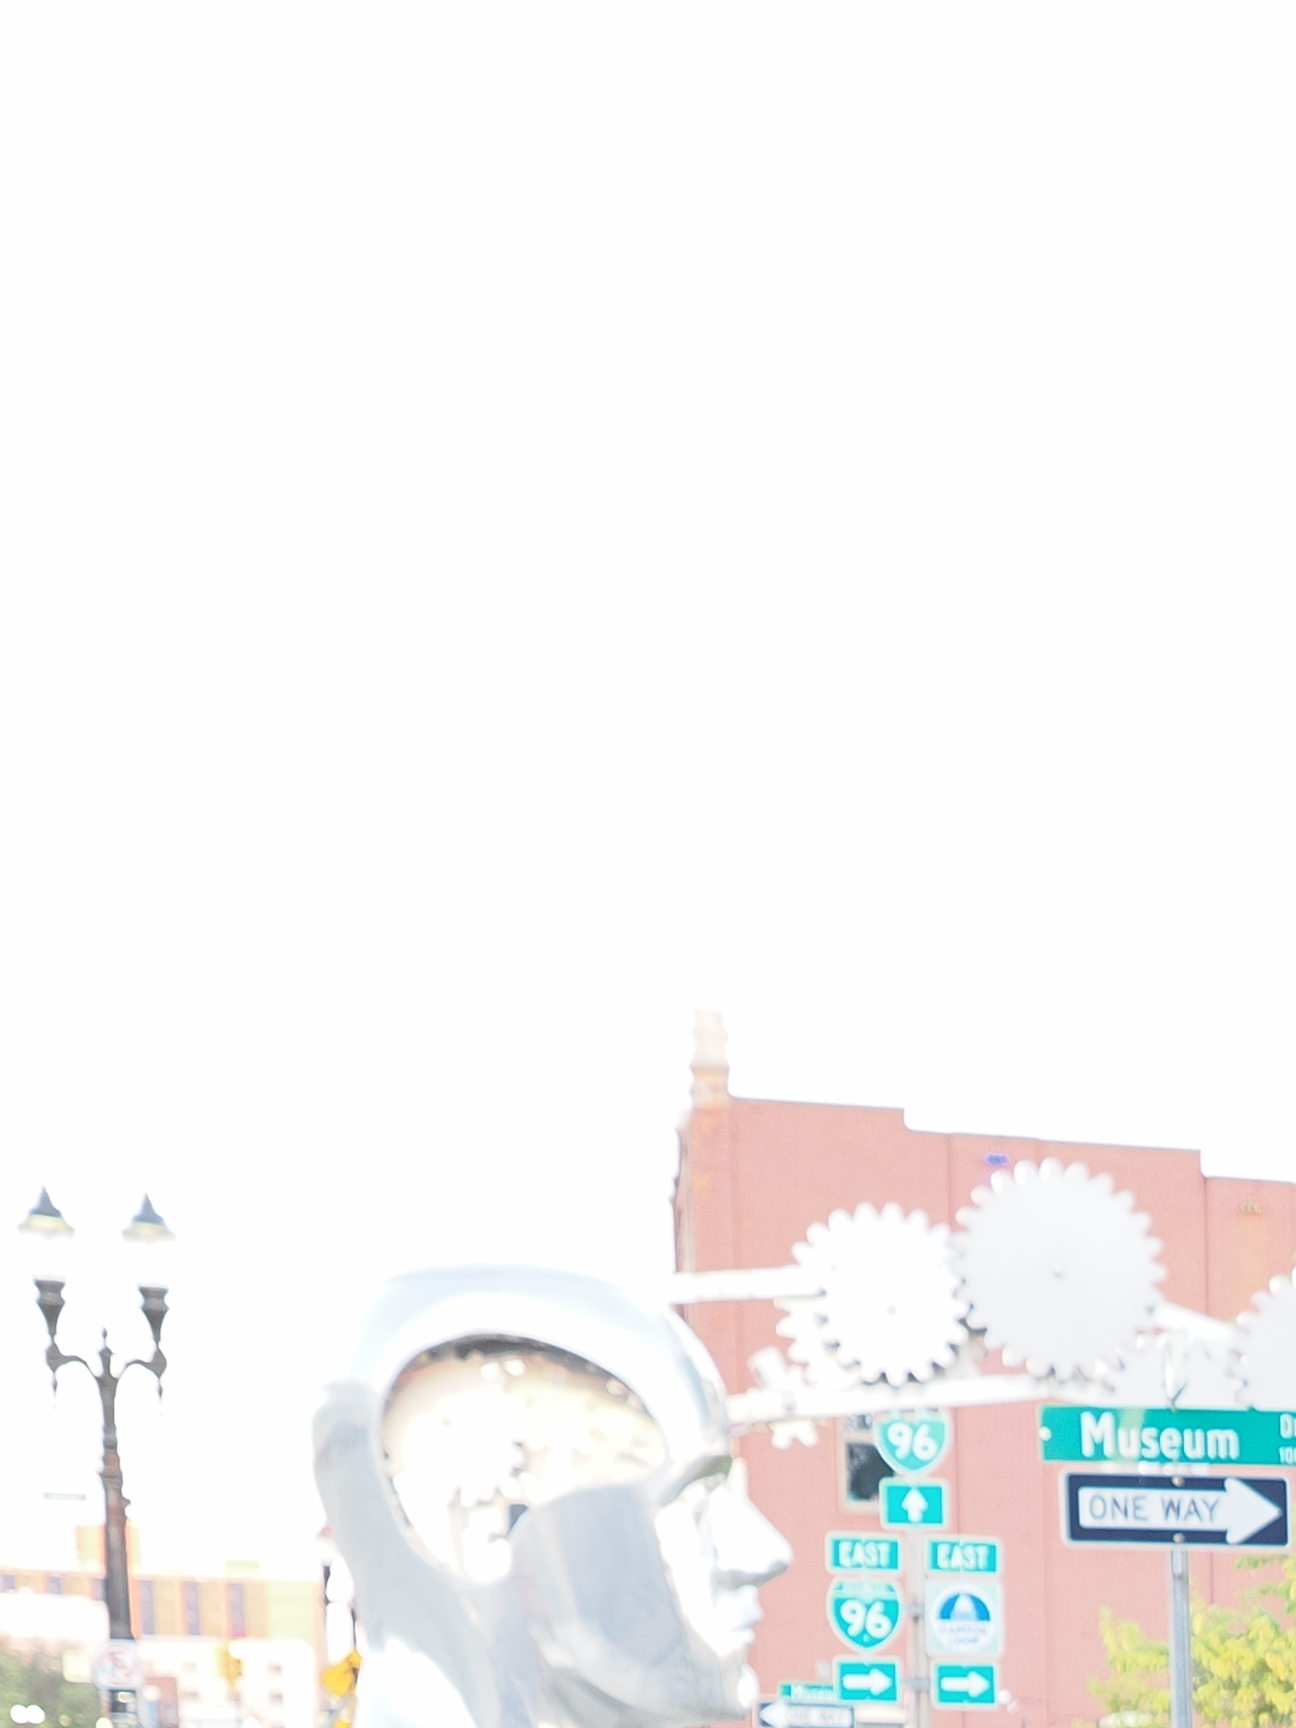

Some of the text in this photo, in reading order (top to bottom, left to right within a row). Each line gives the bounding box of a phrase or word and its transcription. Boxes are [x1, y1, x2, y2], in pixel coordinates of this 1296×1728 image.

[887, 1422, 937, 1461] 96
[1080, 1410, 1239, 1460] Museum
[1089, 1494, 1220, 1522] ONE WAY
[838, 1540, 891, 1568] EAST
[936, 1543, 989, 1571] EAST
[839, 1599, 893, 1639] 96
